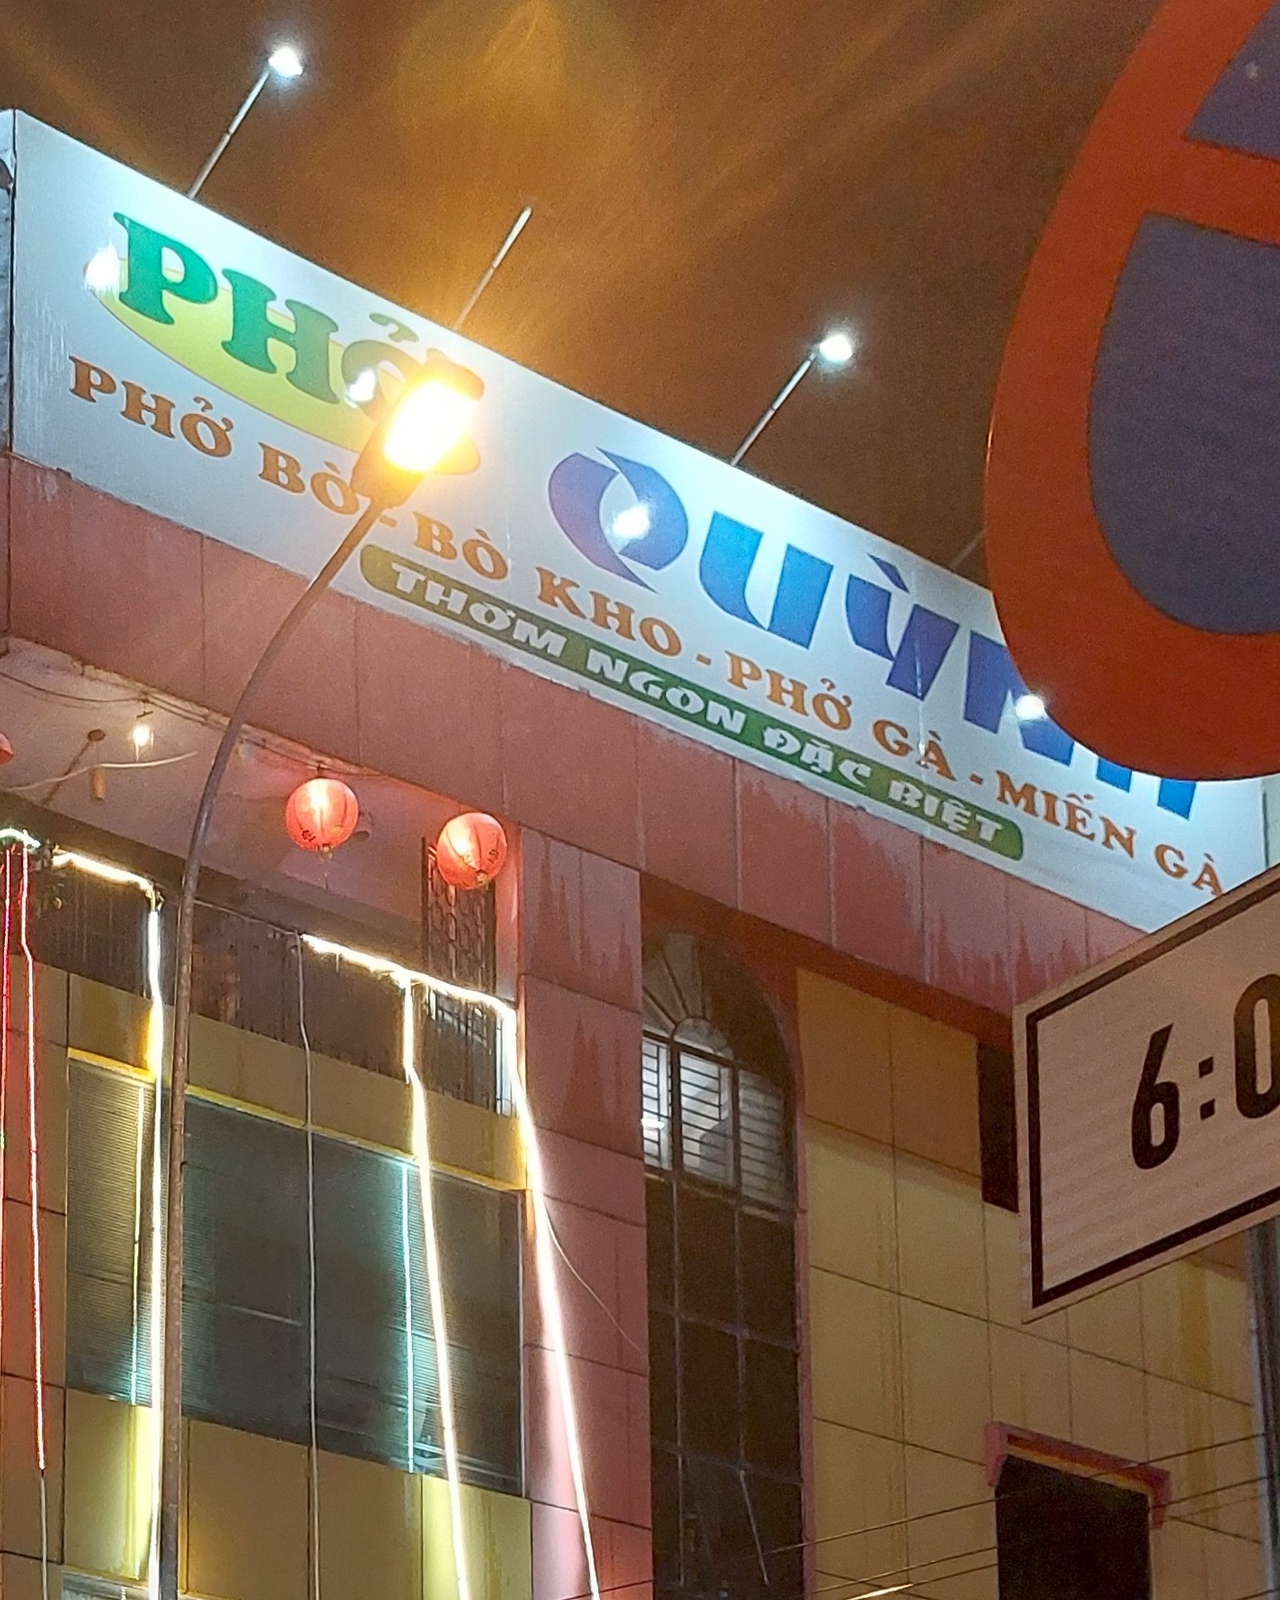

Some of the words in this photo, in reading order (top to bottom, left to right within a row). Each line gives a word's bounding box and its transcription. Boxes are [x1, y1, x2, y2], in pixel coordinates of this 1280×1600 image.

[68, 355, 234, 458] PHỞ
[257, 442, 361, 516] BÒ
[412, 511, 509, 581] BÒ
[536, 566, 682, 657] KHO
[725, 649, 852, 731] PHỞ
[872, 719, 957, 782] GÀ
[995, 769, 1138, 859] MIẾN
[1154, 844, 1224, 897] GÀ
[390, 560, 568, 659] THƠM
[585, 648, 747, 736] NGON
[761, 725, 872, 788] ĐẶC
[887, 779, 1004, 842] BIỆT
[548, 447, 1199, 821] QUỲN
